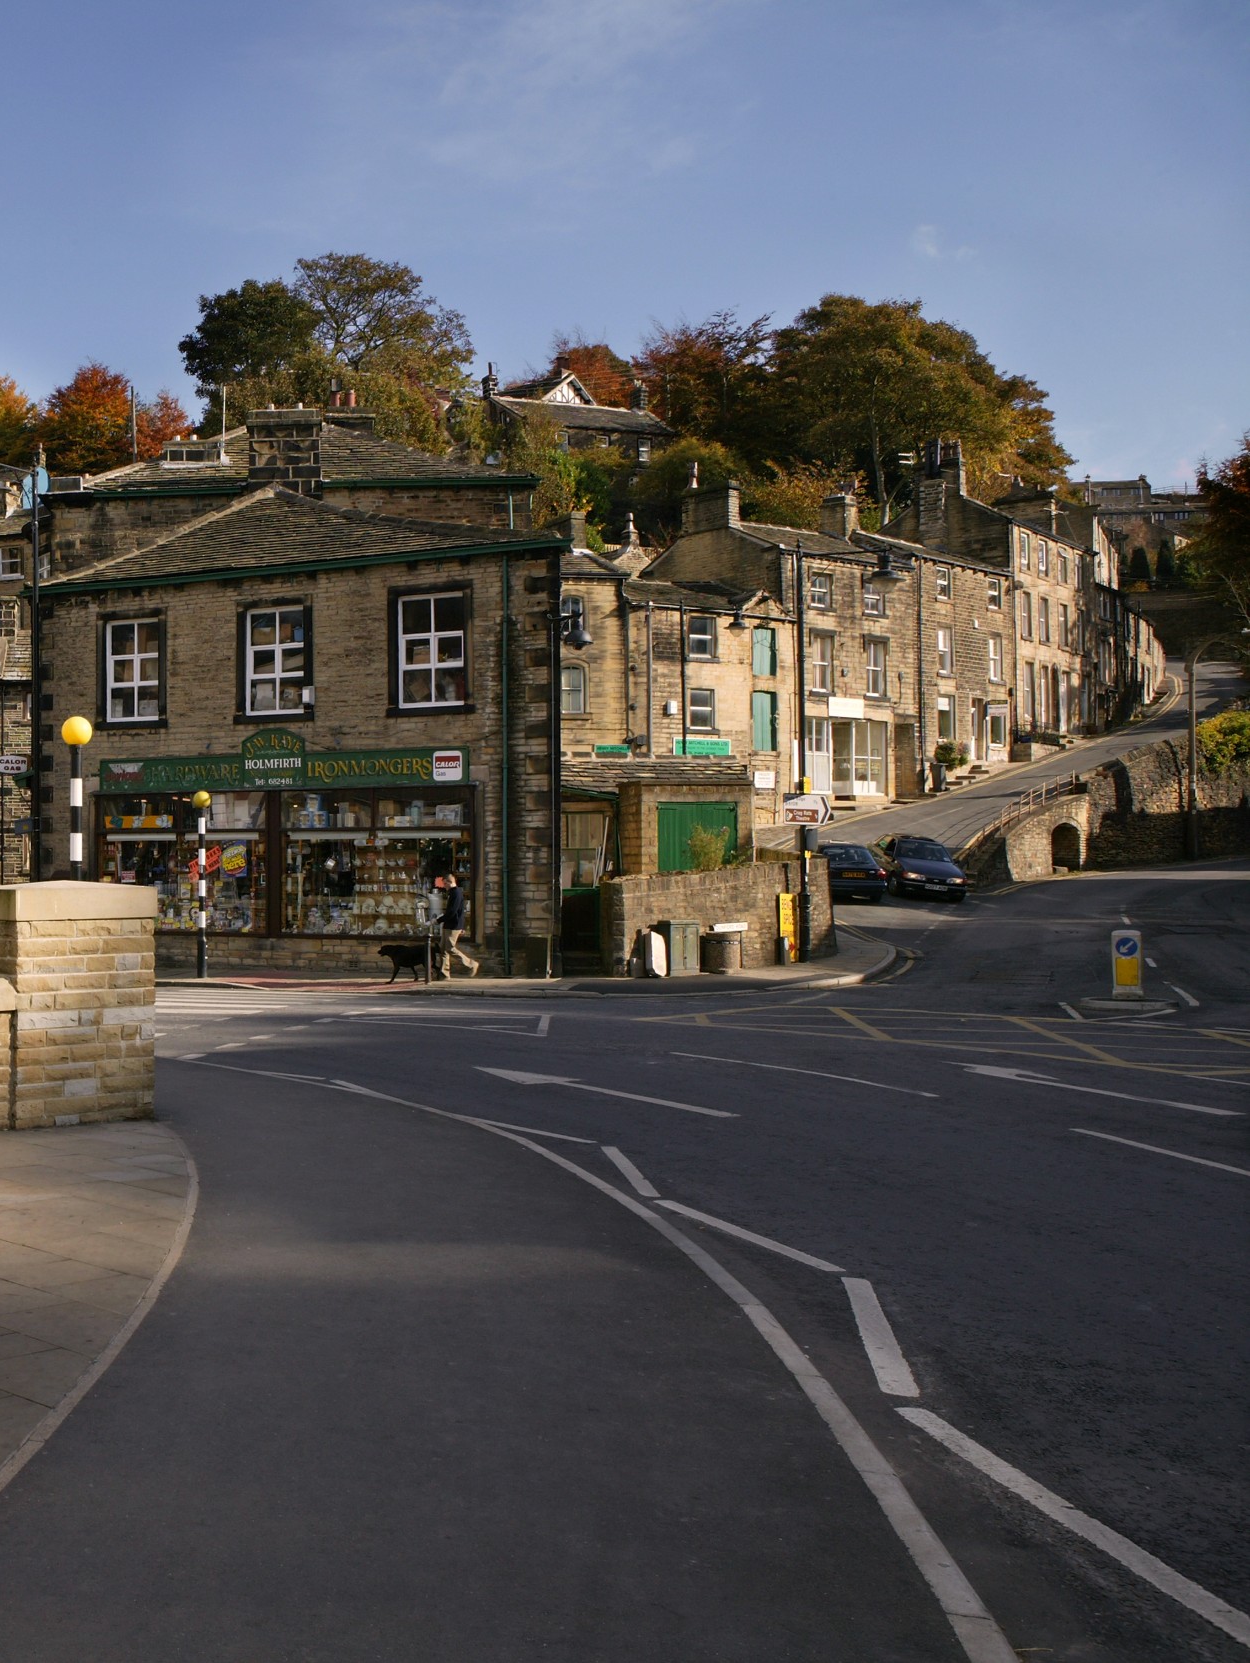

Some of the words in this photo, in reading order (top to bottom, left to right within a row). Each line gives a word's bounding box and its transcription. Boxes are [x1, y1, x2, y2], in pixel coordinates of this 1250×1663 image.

[271, 734, 301, 753] KAYE
[244, 757, 302, 769] HOLMFIRTH
[435, 760, 460, 769] CALOR
[307, 757, 432, 783] IRONMONGERS
[255, 778, 266, 786] Tel:
